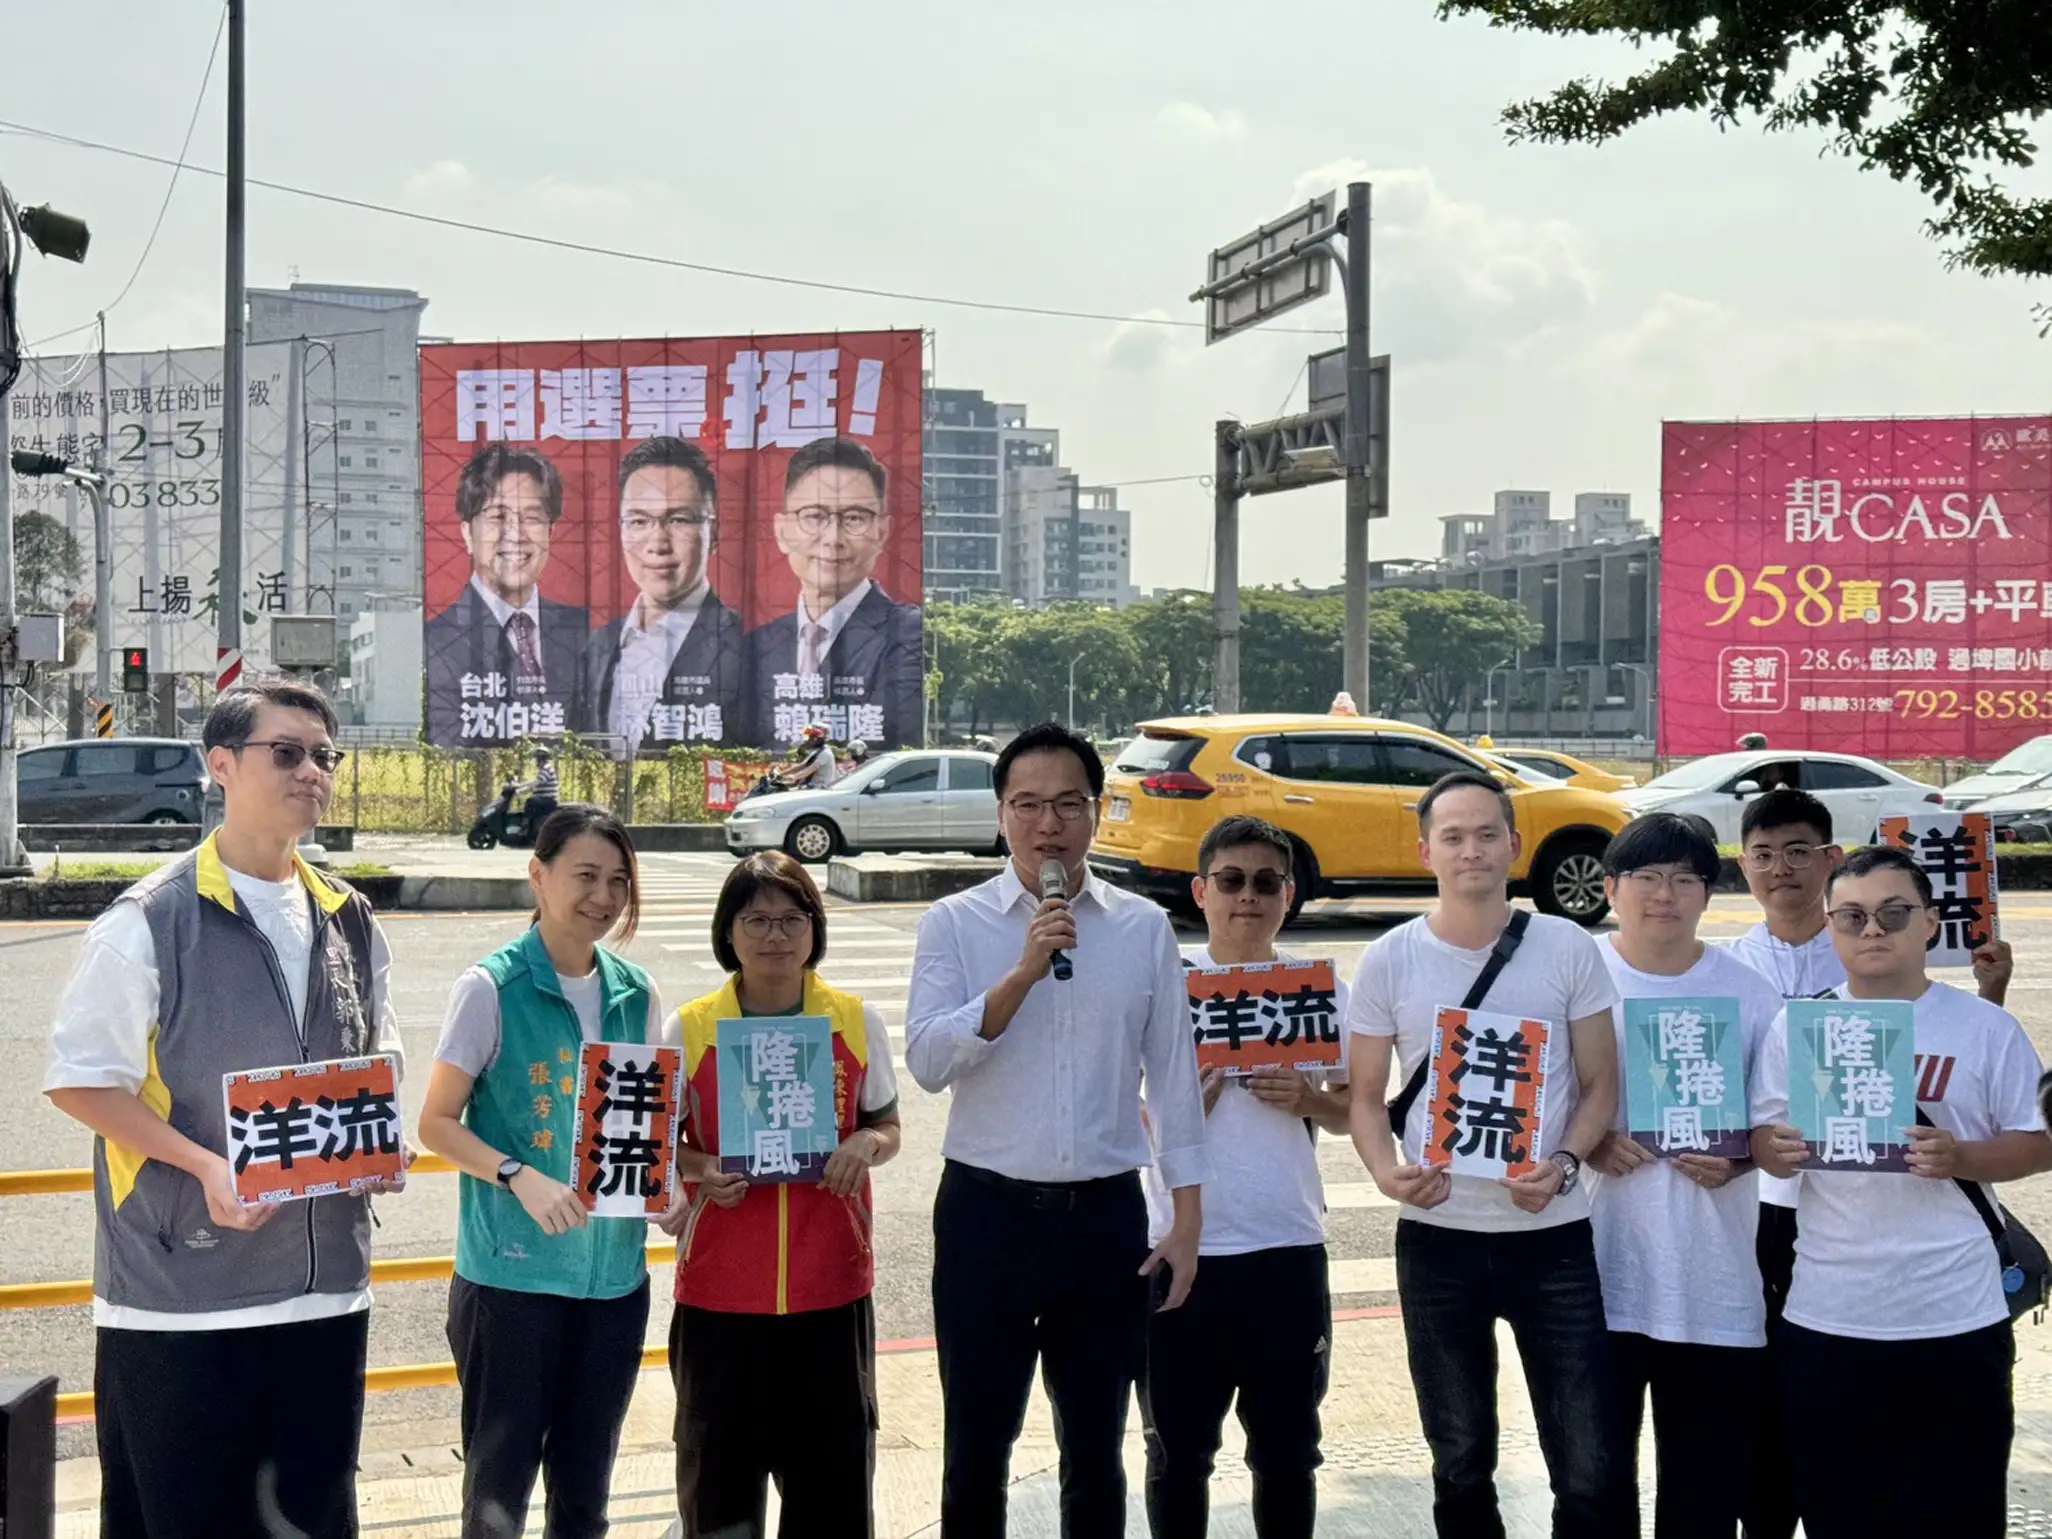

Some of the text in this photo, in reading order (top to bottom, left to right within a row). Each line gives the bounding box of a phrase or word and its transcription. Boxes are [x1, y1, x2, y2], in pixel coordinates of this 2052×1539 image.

[118, 420, 224, 462] 2-3
[459, 671, 507, 698] 台北
[773, 672, 824, 700] 高雄
[1729, 656, 1779, 679] 全新
[1729, 681, 1777, 704] 完工
[460, 701, 566, 740] 沈伯洋
[749, 1031, 816, 1177] 隆捲風
[1440, 1024, 1533, 1165] 洋流
[1658, 1011, 1727, 1152] 隆捲風
[1821, 1015, 1896, 1166] 隆捲風
[229, 1087, 398, 1176] 洋流
[586, 1058, 668, 1197] 洋流
